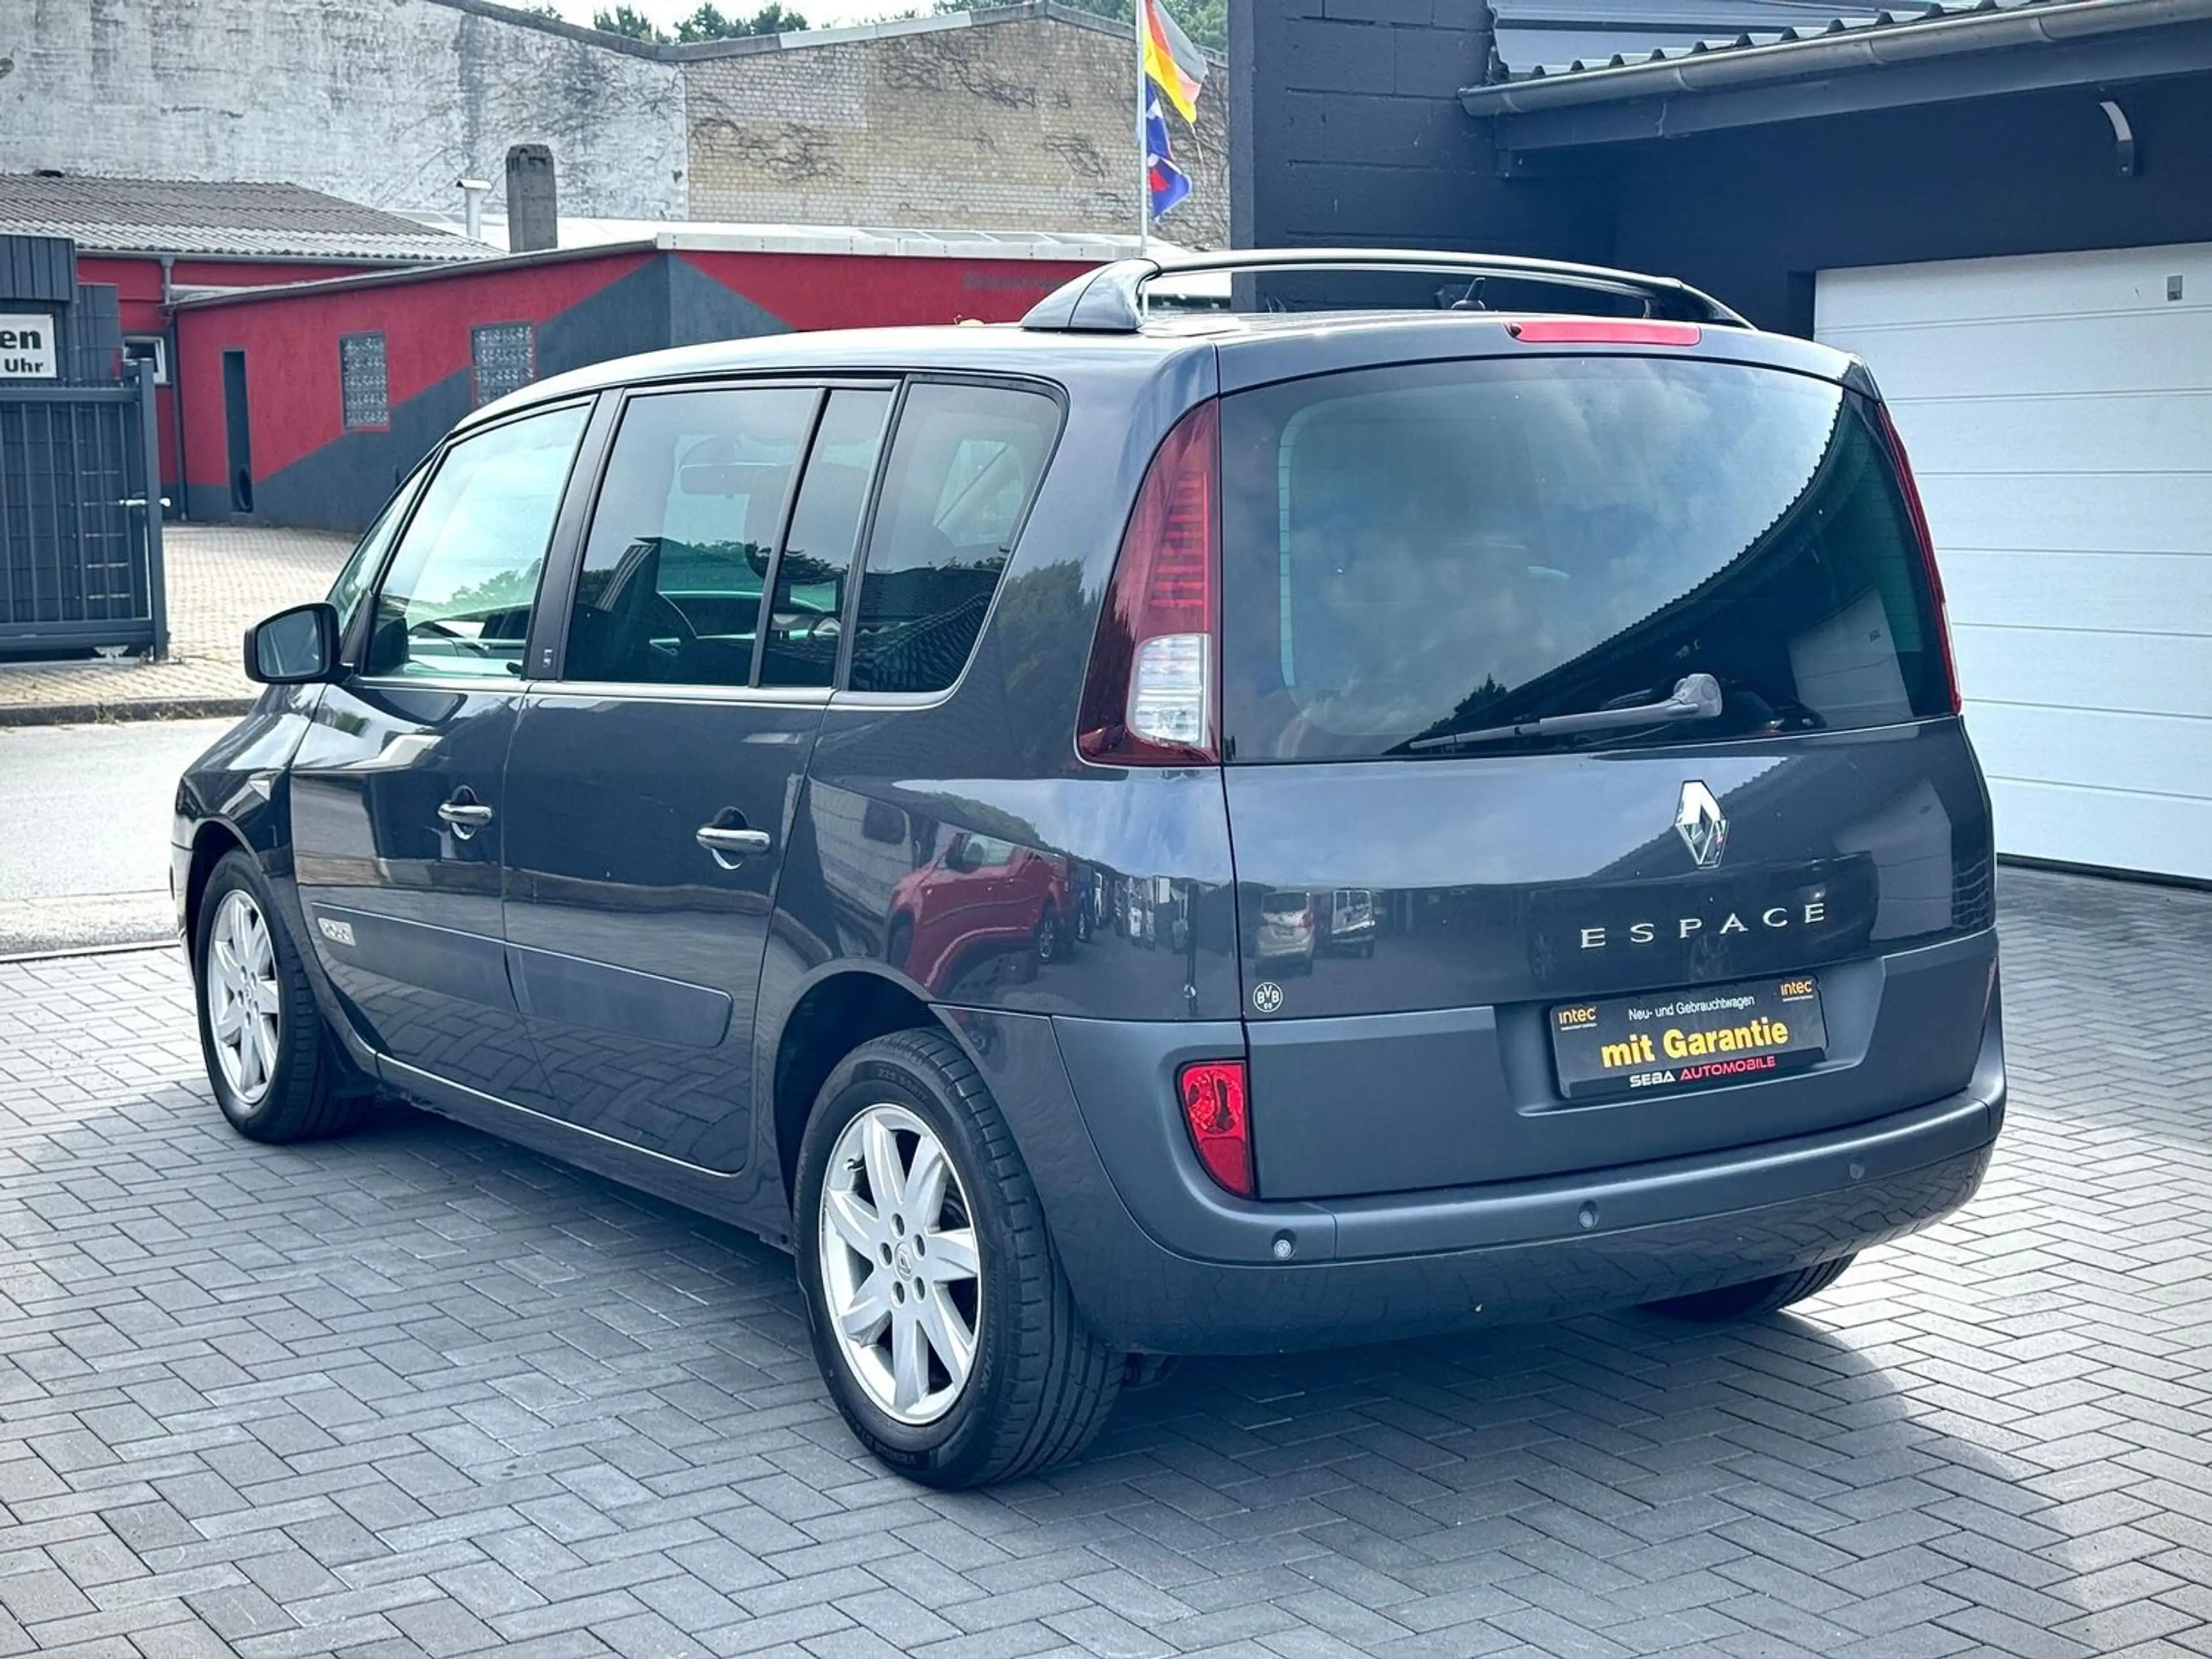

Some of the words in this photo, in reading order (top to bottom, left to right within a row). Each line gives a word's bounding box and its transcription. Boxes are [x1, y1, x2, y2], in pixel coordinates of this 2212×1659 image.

[5, 358, 43, 373] Uhr
[1581, 903, 1825, 949] ESPACE
[1257, 985, 1279, 1004] BVB
[1558, 1009, 1596, 1025] intec
[1628, 1009, 1653, 1020] Neu-
[1654, 1003, 1675, 1017] und
[1676, 996, 1755, 1014] Gebrauchtwagen
[1601, 1034, 1656, 1067] mit
[1663, 1017, 1788, 1058] Garantie
[1630, 1071, 1676, 1088] SEBA
[1680, 1056, 1776, 1081] AUTOMOBILE
